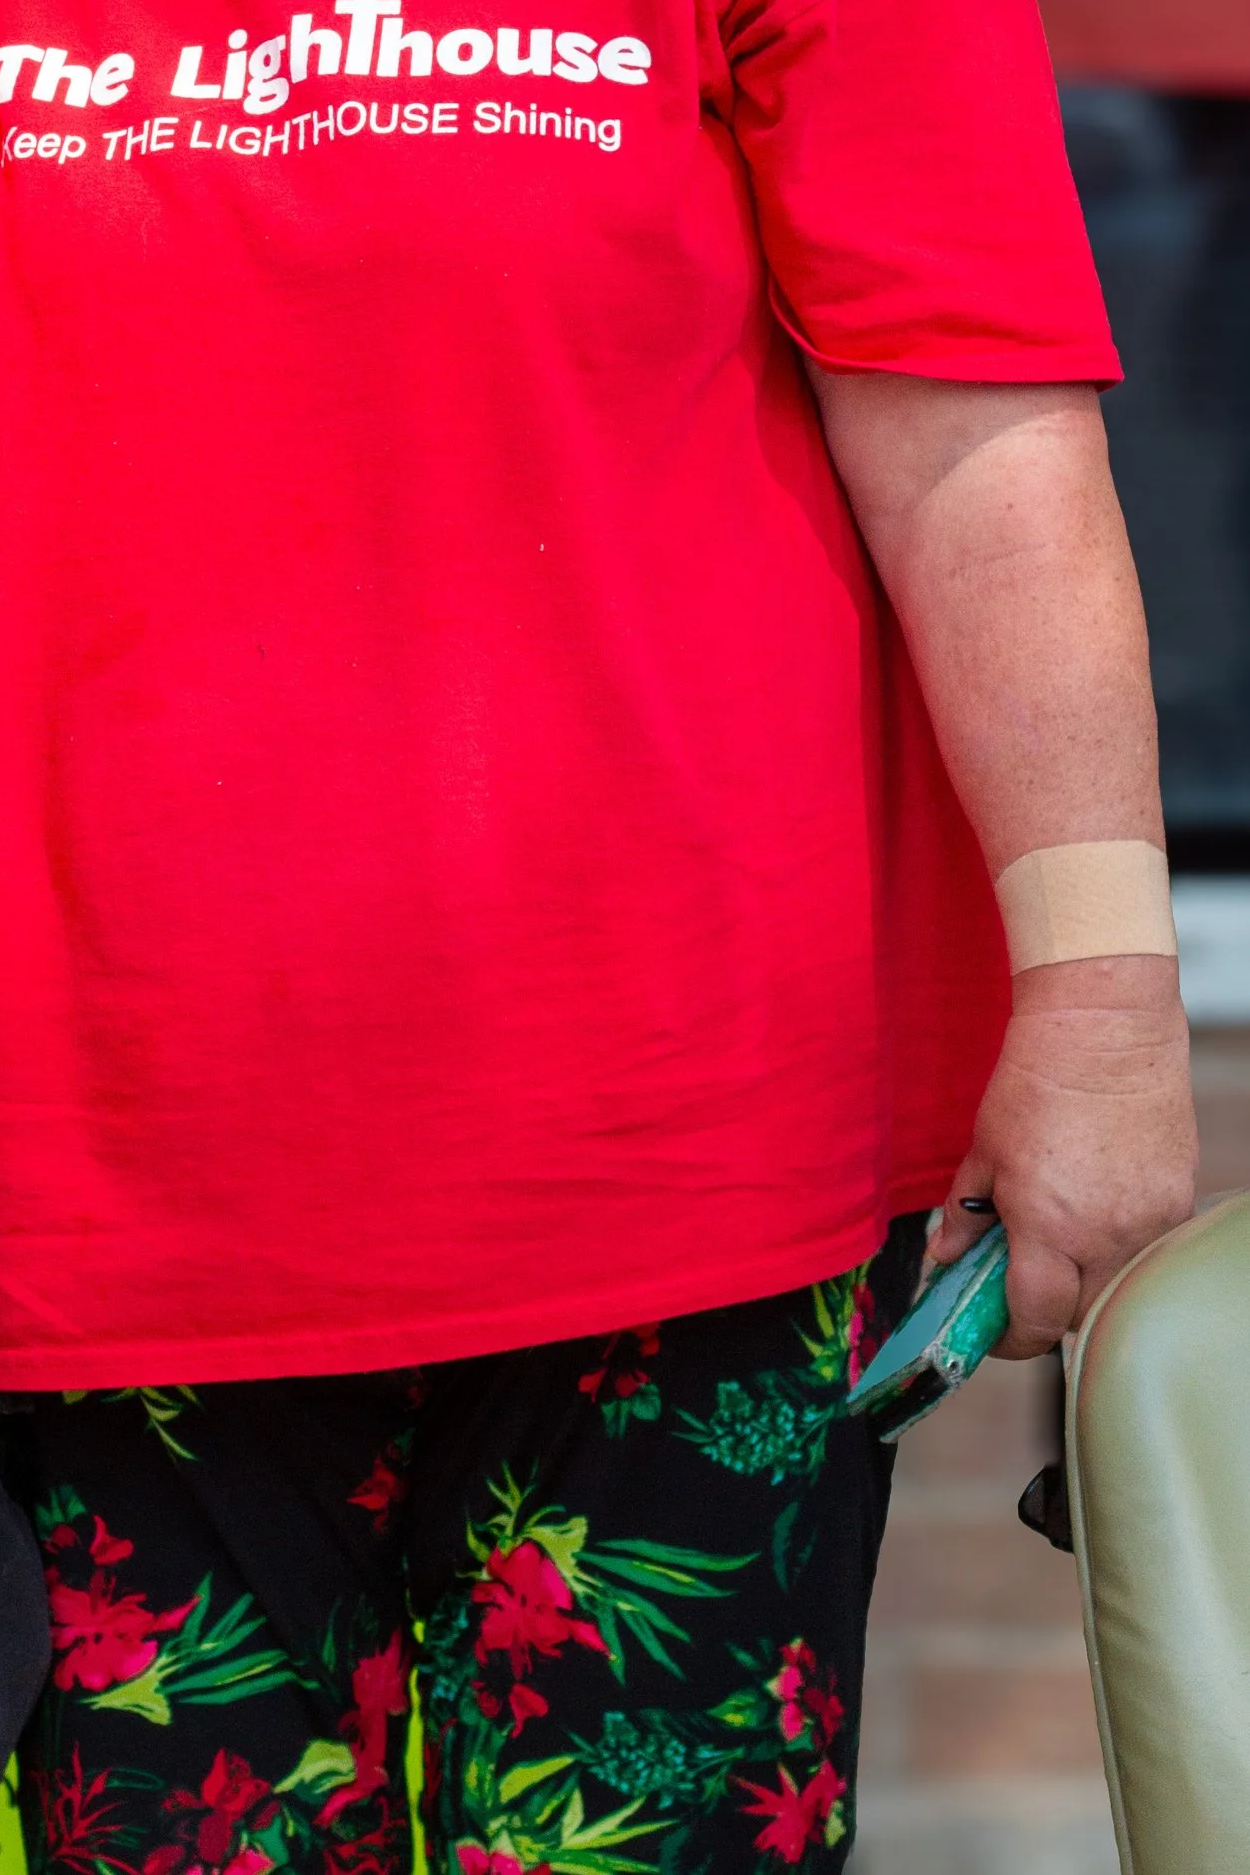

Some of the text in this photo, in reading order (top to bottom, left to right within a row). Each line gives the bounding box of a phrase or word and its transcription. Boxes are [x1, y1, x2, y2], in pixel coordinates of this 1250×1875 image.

[102, 116, 179, 161] THE
[189, 100, 459, 157] LIGHTHOUSE
[473, 101, 621, 153] Shining
